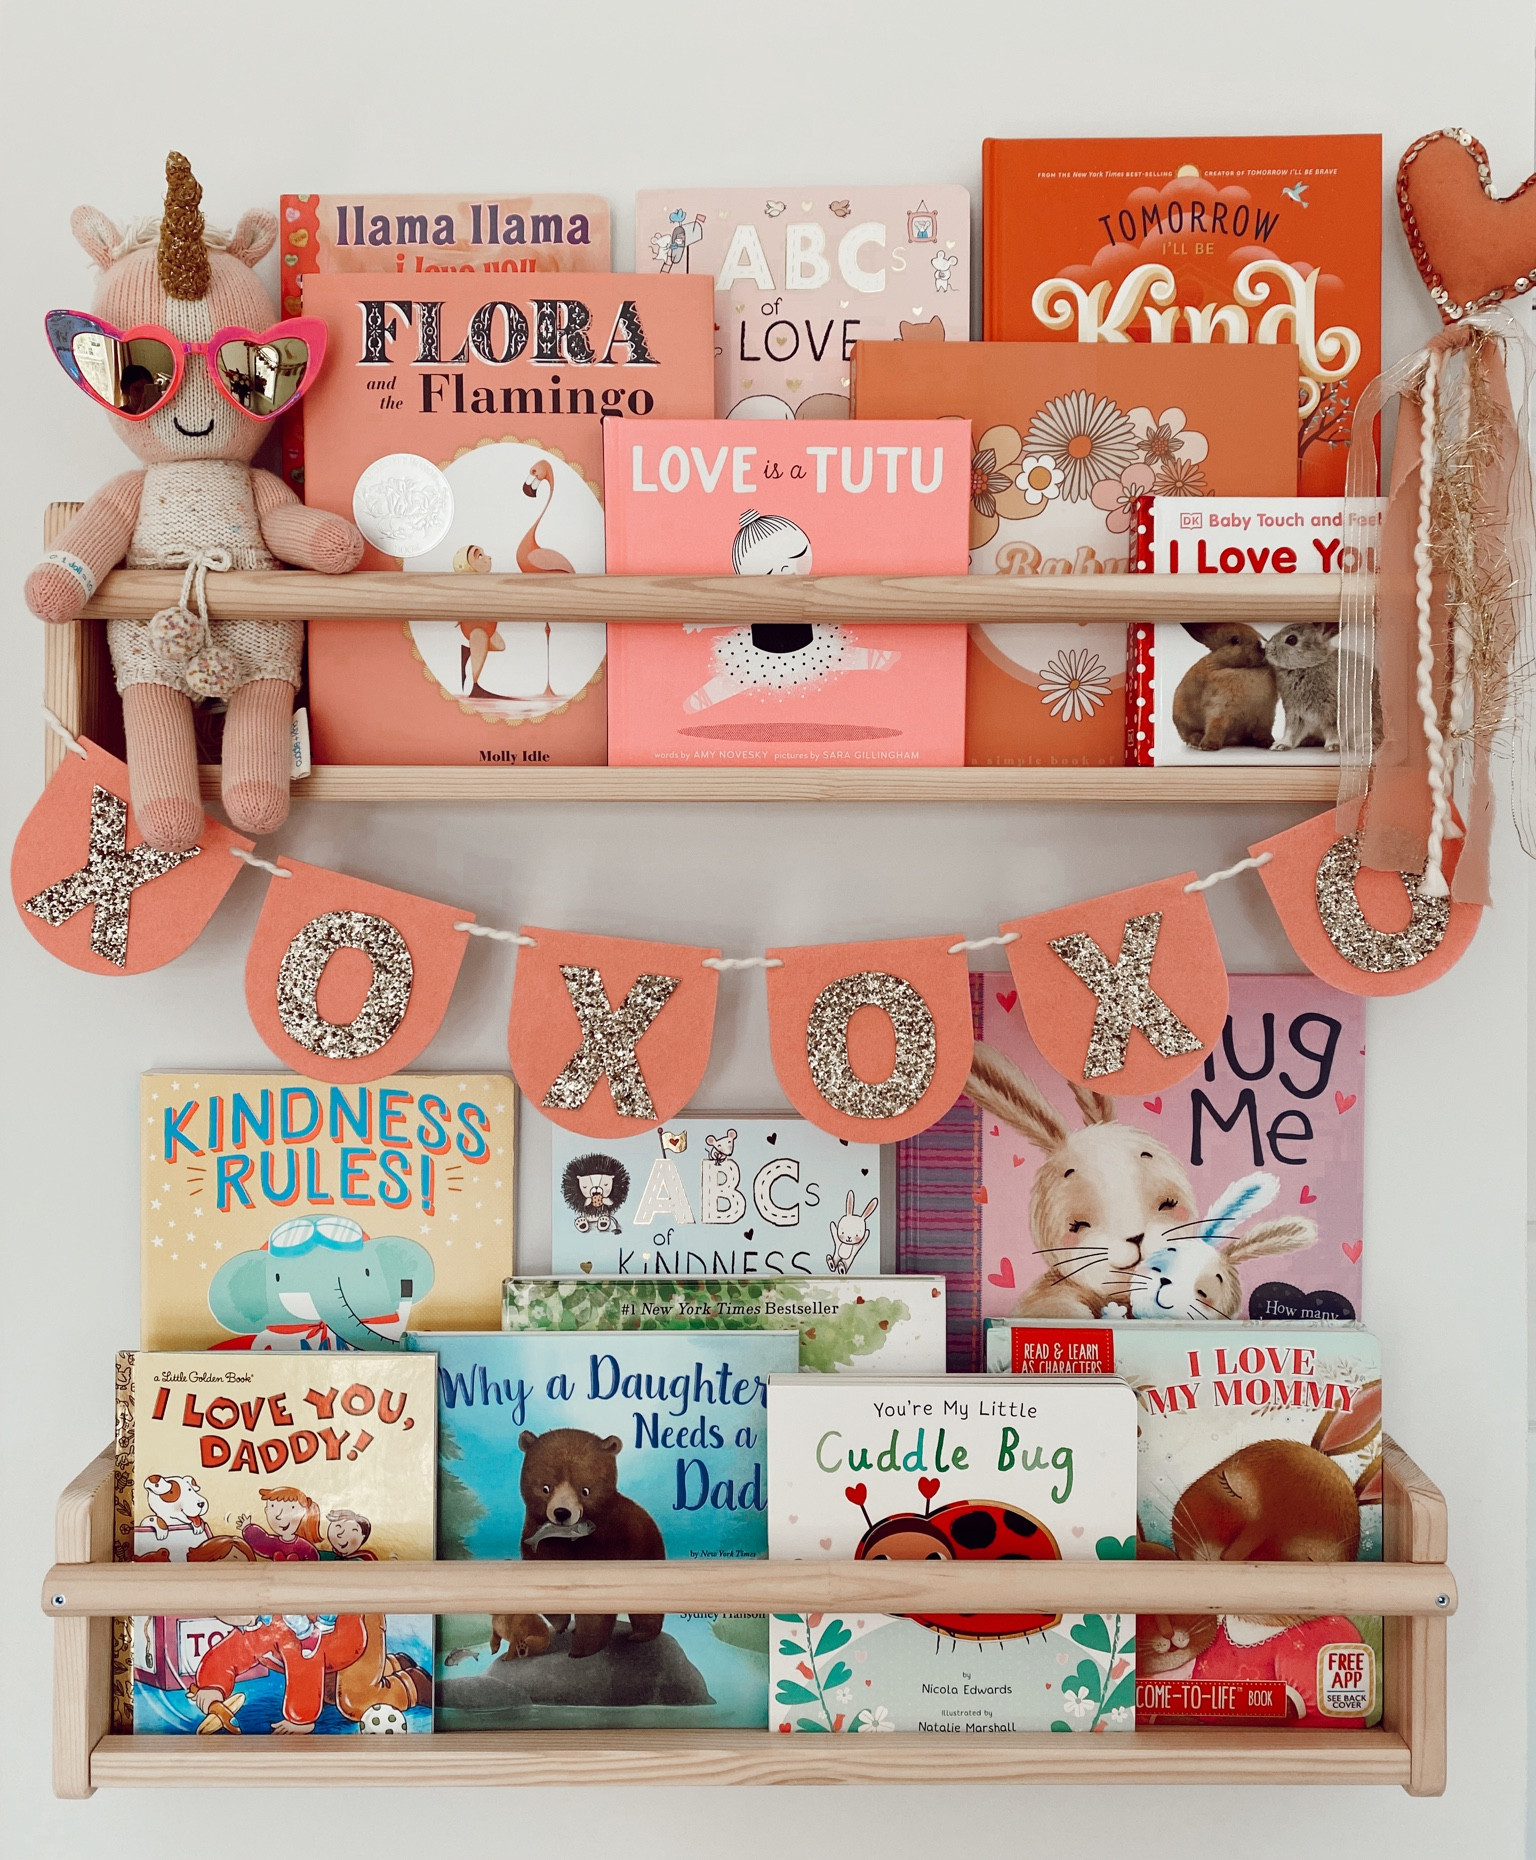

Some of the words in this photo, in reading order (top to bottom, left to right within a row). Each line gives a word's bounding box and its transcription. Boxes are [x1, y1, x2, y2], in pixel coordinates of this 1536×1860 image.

[1247, 168, 1288, 176] TOMORROW
[1315, 167, 1338, 175] BRAVE
[335, 204, 456, 246] llama
[469, 203, 592, 245] llama
[1097, 200, 1280, 247] TOMORROW
[1162, 241, 1189, 256] I'LL
[1195, 241, 1215, 256] BE
[760, 297, 783, 317] of
[1031, 259, 1361, 383] Kind
[355, 298, 662, 367] FLORA
[739, 319, 861, 363] LOVE
[366, 376, 397, 390] and
[379, 396, 404, 411] the
[419, 372, 655, 420] Flamingo
[631, 445, 758, 494] LOVE
[763, 459, 784, 481] is
[789, 463, 808, 480] a
[806, 445, 944, 494] TUTU
[1209, 513, 1252, 530] Baby
[1256, 513, 1305, 527] Touch
[1310, 513, 1342, 527] and
[1169, 539, 1179, 574] I
[1197, 539, 1297, 574] Love
[479, 750, 518, 765] Molly
[522, 750, 551, 762] Idle
[654, 751, 679, 760] words
[680, 751, 691, 761] by
[693, 751, 716, 760] AMY
[719, 751, 769, 760] NOVESKY
[774, 751, 809, 761] pictures
[810, 751, 820, 761] by
[822, 751, 851, 760] SARA
[853, 751, 919, 760] GILLINGHAM
[1050, 756, 1090, 765] book
[22, 785, 201, 969] X
[276, 910, 414, 1060] O
[541, 964, 683, 1121] X
[806, 971, 937, 1119] O
[1046, 911, 1205, 1080] X
[1203, 1012, 1342, 1100] ug
[164, 1085, 491, 1165] KINDNESS
[1190, 1087, 1314, 1167] Me
[216, 1146, 436, 1217] RULES!
[653, 1228, 675, 1246] of
[621, 1303, 636, 1316] #1
[641, 1303, 674, 1316] New
[677, 1303, 712, 1316] York
[716, 1303, 762, 1315] Times
[765, 1302, 839, 1315] Bestseller
[1265, 1300, 1298, 1317] How
[1301, 1308, 1340, 1320] many
[1024, 1343, 1049, 1360] READ
[1054, 1342, 1064, 1360] &
[1068, 1343, 1099, 1360] LEARN
[1021, 1360, 1035, 1374] AS
[1039, 1360, 1103, 1374] CHARACTERS
[1187, 1350, 1201, 1378] I
[1213, 1346, 1316, 1376] LOVE
[162, 1371, 188, 1384] Little
[188, 1371, 225, 1383] Golden
[438, 1362, 534, 1427] Why
[545, 1373, 576, 1401] a
[586, 1354, 768, 1417] Daughter
[1147, 1382, 1201, 1416] MY
[1212, 1378, 1361, 1412] MOMMY
[151, 1386, 171, 1421] I
[182, 1391, 295, 1433] LOVE
[302, 1382, 416, 1432] YOU,
[873, 1399, 934, 1418] You're
[943, 1399, 969, 1421] My
[979, 1400, 1038, 1419] Little
[632, 1411, 725, 1450] Needs
[734, 1425, 758, 1450] a
[198, 1425, 375, 1475] DADDY!
[815, 1427, 970, 1474] Cuddle
[997, 1426, 1075, 1505] Bug
[672, 1457, 768, 1512] Dad
[690, 1549, 699, 1559] by
[700, 1549, 717, 1558] New
[718, 1549, 734, 1558] York
[735, 1549, 756, 1558] Times
[1327, 1652, 1365, 1671] FREE
[962, 1671, 972, 1681] by
[1331, 1671, 1363, 1689] APP
[921, 1683, 959, 1695] Nicola
[963, 1684, 1013, 1695] Edwards
[1248, 1690, 1273, 1707] BOOK
[1326, 1694, 1342, 1703] SEE
[1343, 1694, 1367, 1703] BACK
[941, 1709, 982, 1717] Illustrated
[983, 1709, 993, 1718] by
[1332, 1701, 1362, 1709] COVER
[918, 1721, 961, 1733] Natalie
[965, 1722, 1017, 1733] Marshall
